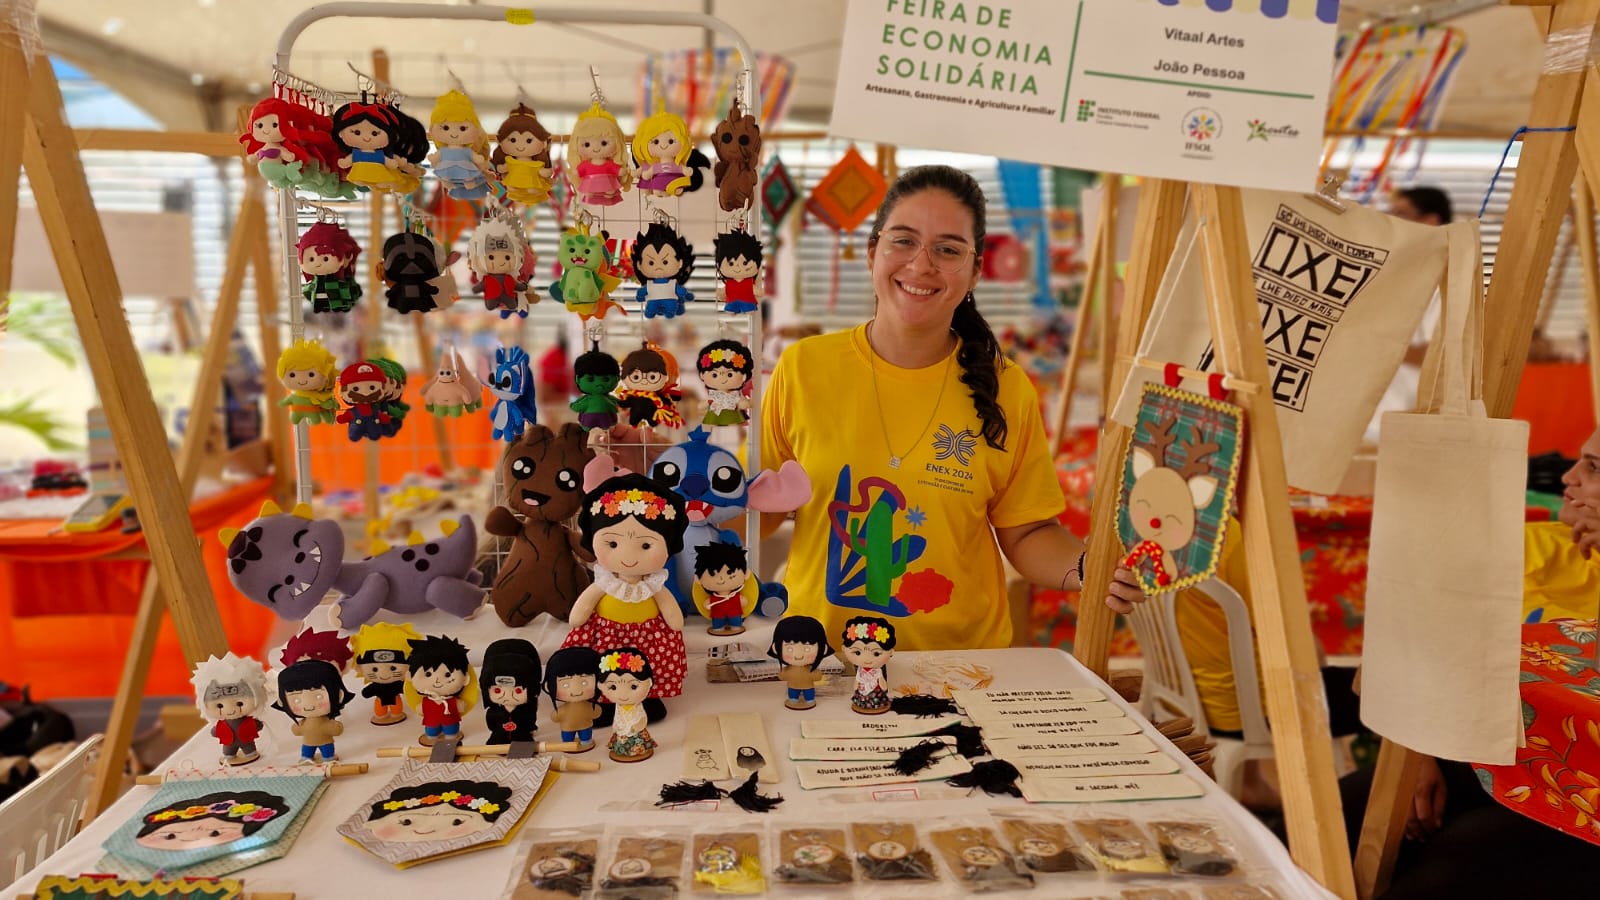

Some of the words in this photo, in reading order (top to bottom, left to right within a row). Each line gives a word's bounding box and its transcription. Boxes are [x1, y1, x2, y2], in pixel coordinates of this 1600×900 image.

[886, 0, 967, 24] FEIRA
[976, 6, 1012, 29] DE
[882, 24, 1053, 66] ECONOMIA
[1164, 27, 1204, 44] Vitaal
[1206, 33, 1245, 48] Artes
[876, 54, 1038, 95] SOLIDÁRIA
[1153, 59, 1189, 74] João
[1192, 63, 1245, 80] Pessoa
[865, 83, 913, 99] Artesanato,
[914, 90, 966, 105] Gastronomia
[975, 98, 1021, 114] Agricultura
[1022, 104, 1056, 116] Familiar
[1259, 226, 1373, 308] OXE!
[1260, 277, 1281, 296] LHE
[1284, 290, 1308, 306] DIGO
[926, 463, 950, 475] ENEX
[952, 468, 973, 481] 2024
